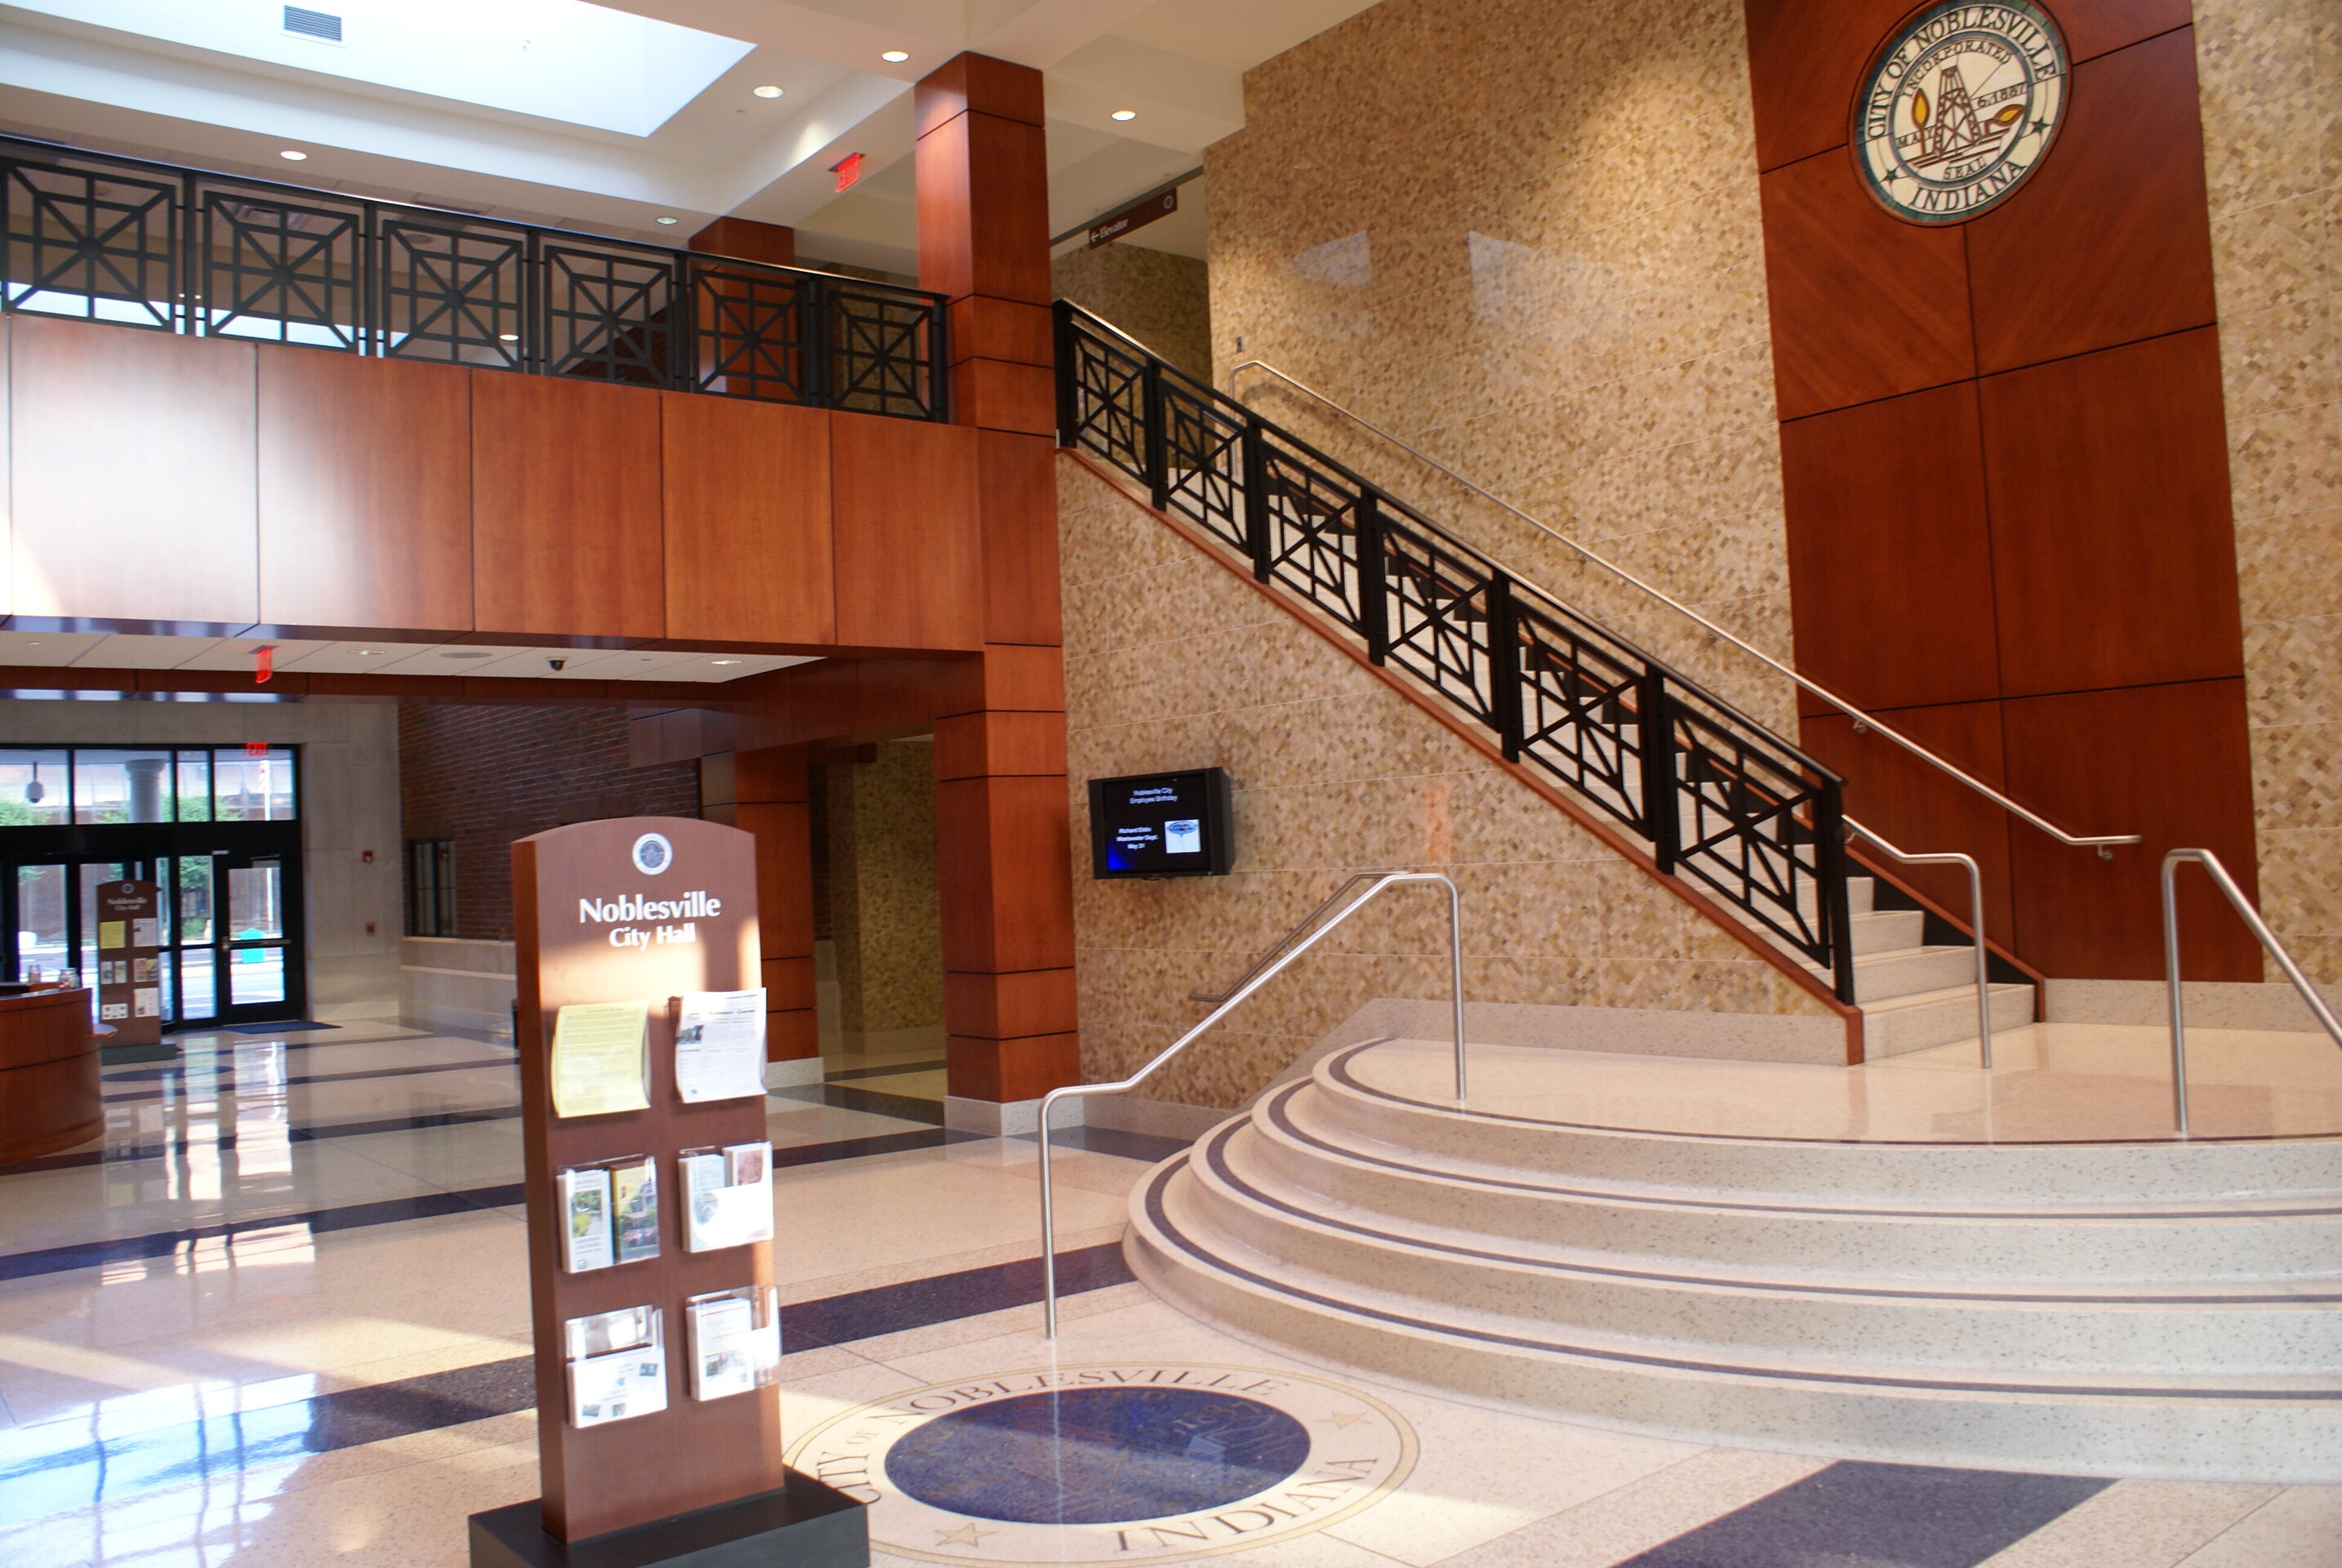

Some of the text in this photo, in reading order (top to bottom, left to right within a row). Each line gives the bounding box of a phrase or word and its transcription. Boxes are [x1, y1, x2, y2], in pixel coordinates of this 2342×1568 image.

[1868, 7, 2059, 138] CITY OF NOBLESVILLE
[1903, 41, 2014, 97] INCORPORATED
[1911, 161, 2027, 210] INDIANA
[1943, 156, 1988, 180] SEAL
[579, 890, 722, 924] Noblesville
[608, 922, 697, 951] City Hall
[845, 1428, 880, 1446] OF
[869, 1369, 1292, 1424] NOBLESVILLE
[1115, 1455, 1381, 1551] INDIANA
